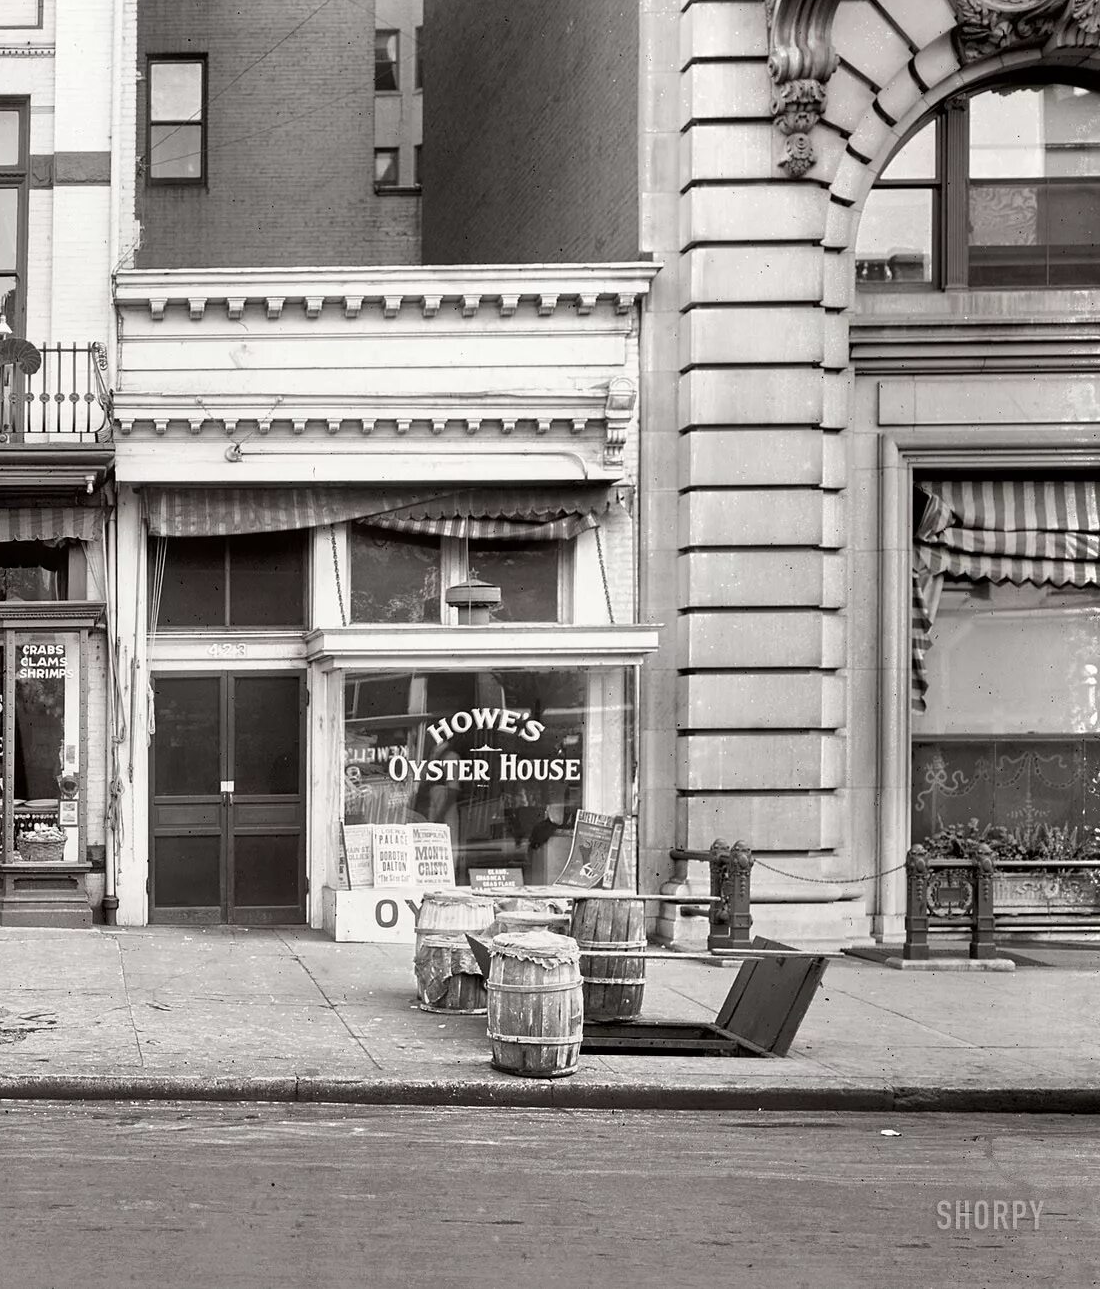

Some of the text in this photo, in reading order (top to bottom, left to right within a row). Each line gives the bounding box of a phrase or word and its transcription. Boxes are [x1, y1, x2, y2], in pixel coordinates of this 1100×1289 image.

[22, 645, 64, 655] CRABS
[208, 643, 246, 656] 423
[21, 657, 68, 667] CLAMS
[19, 668, 74, 679] SHRIMPS
[426, 707, 545, 745] HOWE'S
[389, 754, 581, 781] OYSTER HOUSE
[379, 834, 408, 845] PALACE
[380, 850, 408, 861] DOROTHY
[415, 846, 449, 860] MONTE
[382, 862, 406, 871] DALTON
[418, 862, 448, 876] CRISTO
